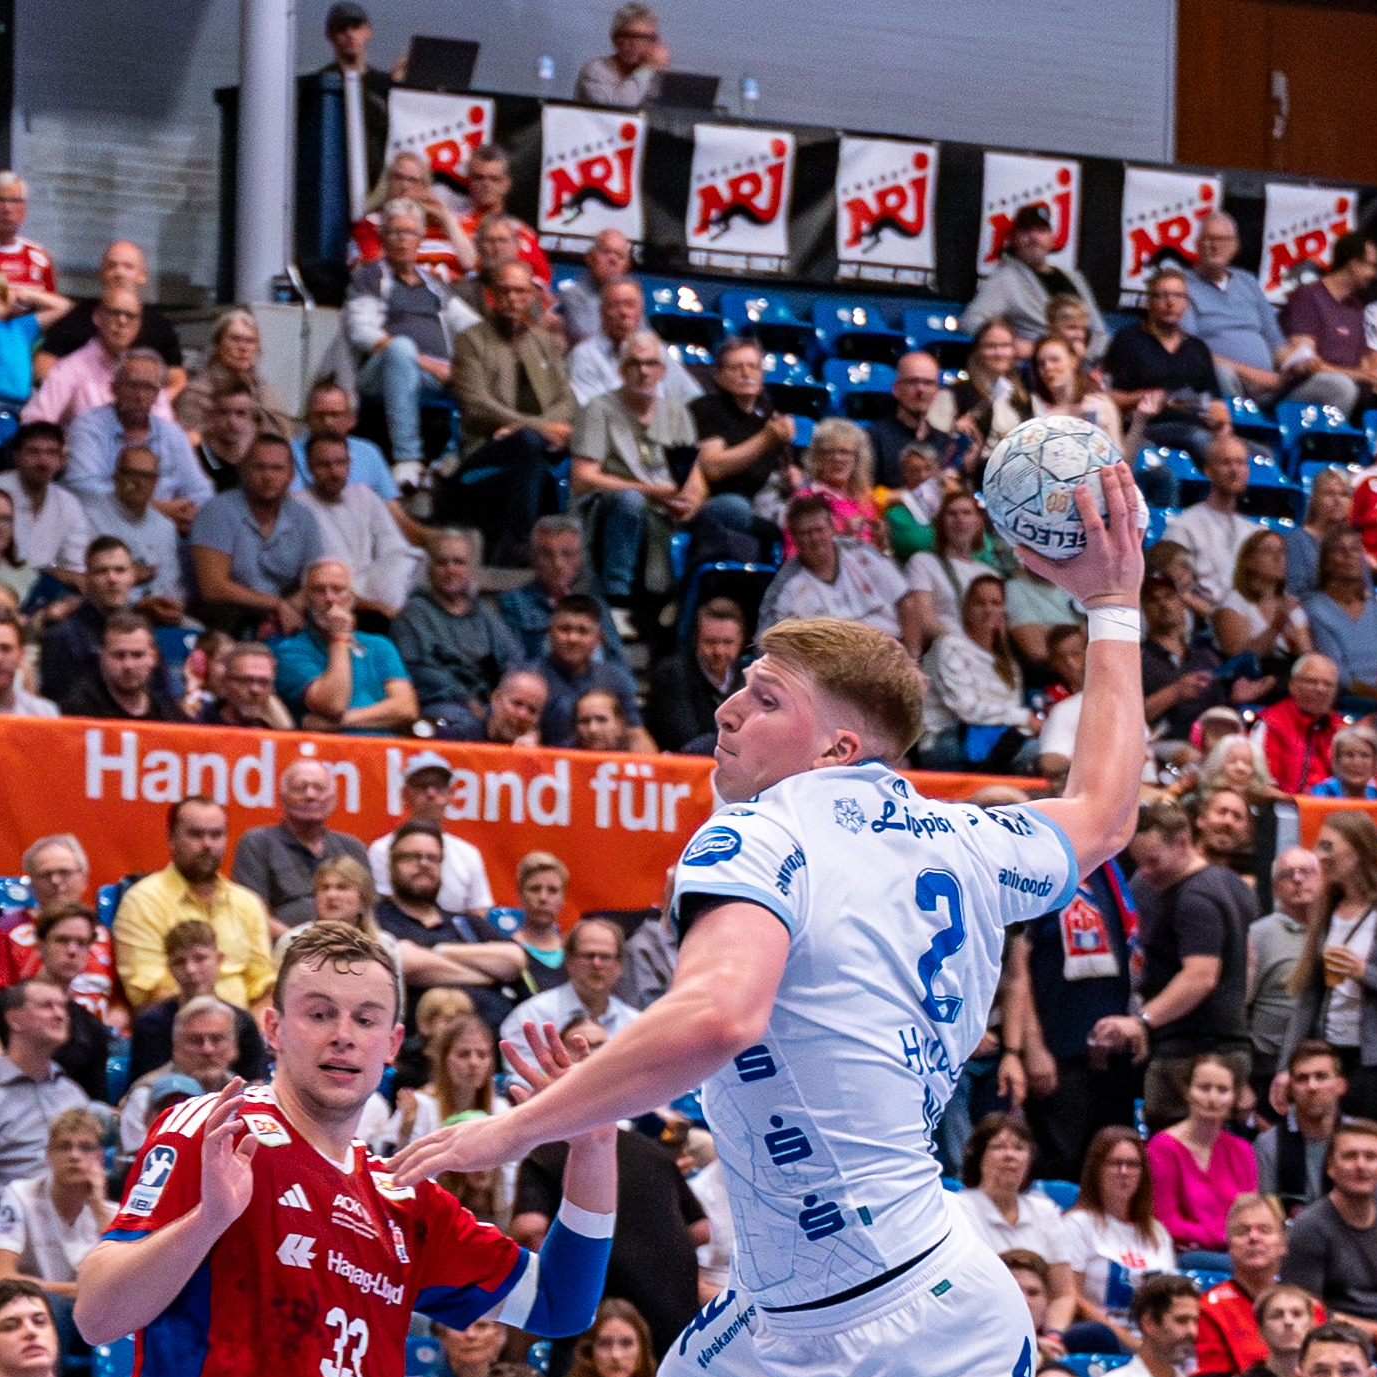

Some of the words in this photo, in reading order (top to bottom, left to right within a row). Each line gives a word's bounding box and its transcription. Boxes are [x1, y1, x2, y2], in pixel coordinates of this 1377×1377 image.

[546, 122, 636, 218] NRJ
[694, 138, 786, 236] NRJ
[844, 152, 929, 248] NRJ
[983, 168, 1071, 263] NJ
[85, 729, 276, 810] Hand
[590, 760, 691, 832] für
[915, 867, 967, 1025] 2
[254, 1118, 281, 1134] Dole
